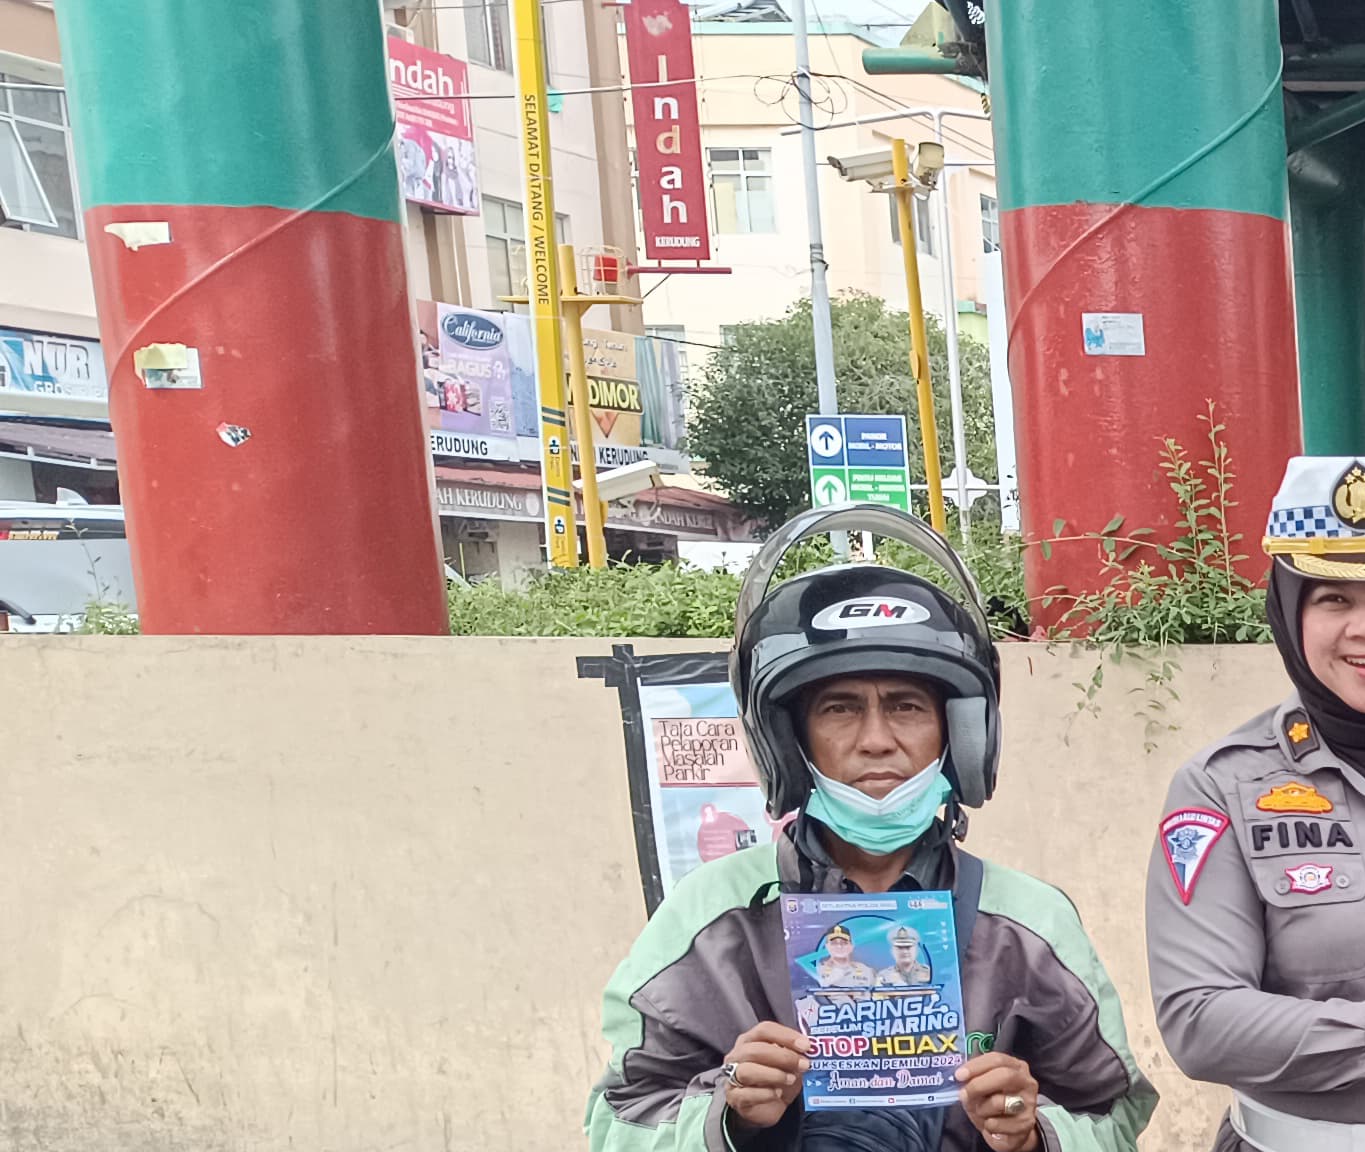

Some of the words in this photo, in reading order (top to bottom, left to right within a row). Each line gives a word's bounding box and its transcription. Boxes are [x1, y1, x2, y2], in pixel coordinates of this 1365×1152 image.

[524, 95, 541, 161] SELAMAT
[529, 163, 544, 222] DATANG
[533, 235, 550, 305] WELCOME
[443, 315, 501, 345] California
[23, 339, 90, 379] NUR
[455, 487, 523, 511] KERUDUNG
[838, 603, 908, 619] GM
[696, 720, 736, 737] Cara
[660, 735, 738, 755] Pelaporan
[663, 764, 711, 781] Parkir
[1251, 821, 1354, 851] FINA
[818, 996, 923, 1025] SARING
[861, 1011, 959, 1037] SHARING
[806, 1036, 869, 1057] STOP
[871, 1033, 959, 1056] HOAX
[881, 1056, 931, 1070] PEMILU
[932, 1054, 963, 1067] 2024
[827, 1070, 869, 1092] Aman
[869, 1074, 896, 1088] dan
[896, 1069, 944, 1089] Damai
